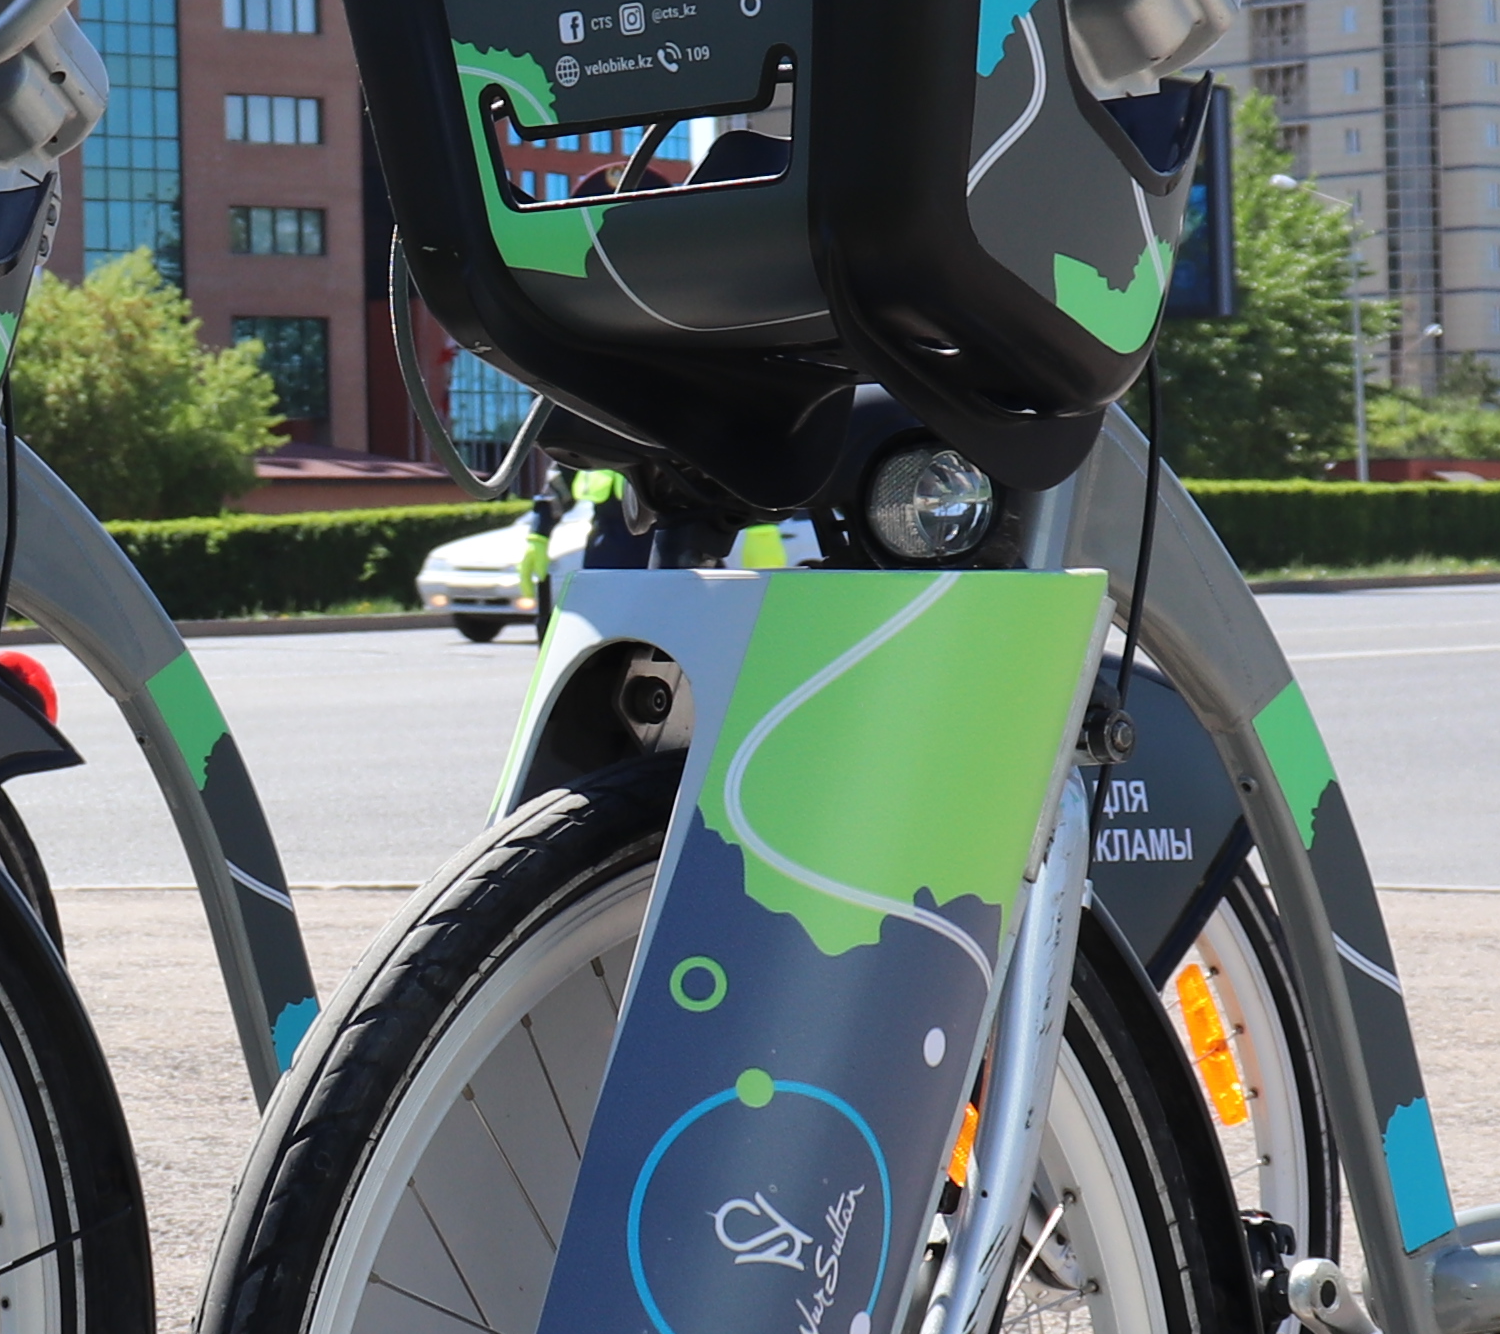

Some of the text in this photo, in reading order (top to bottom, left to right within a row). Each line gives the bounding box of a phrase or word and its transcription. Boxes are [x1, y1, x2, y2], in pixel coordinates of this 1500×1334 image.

[590, 4, 697, 31] CTS @cts_kz
[585, 46, 711, 77] velobike.kz 109
